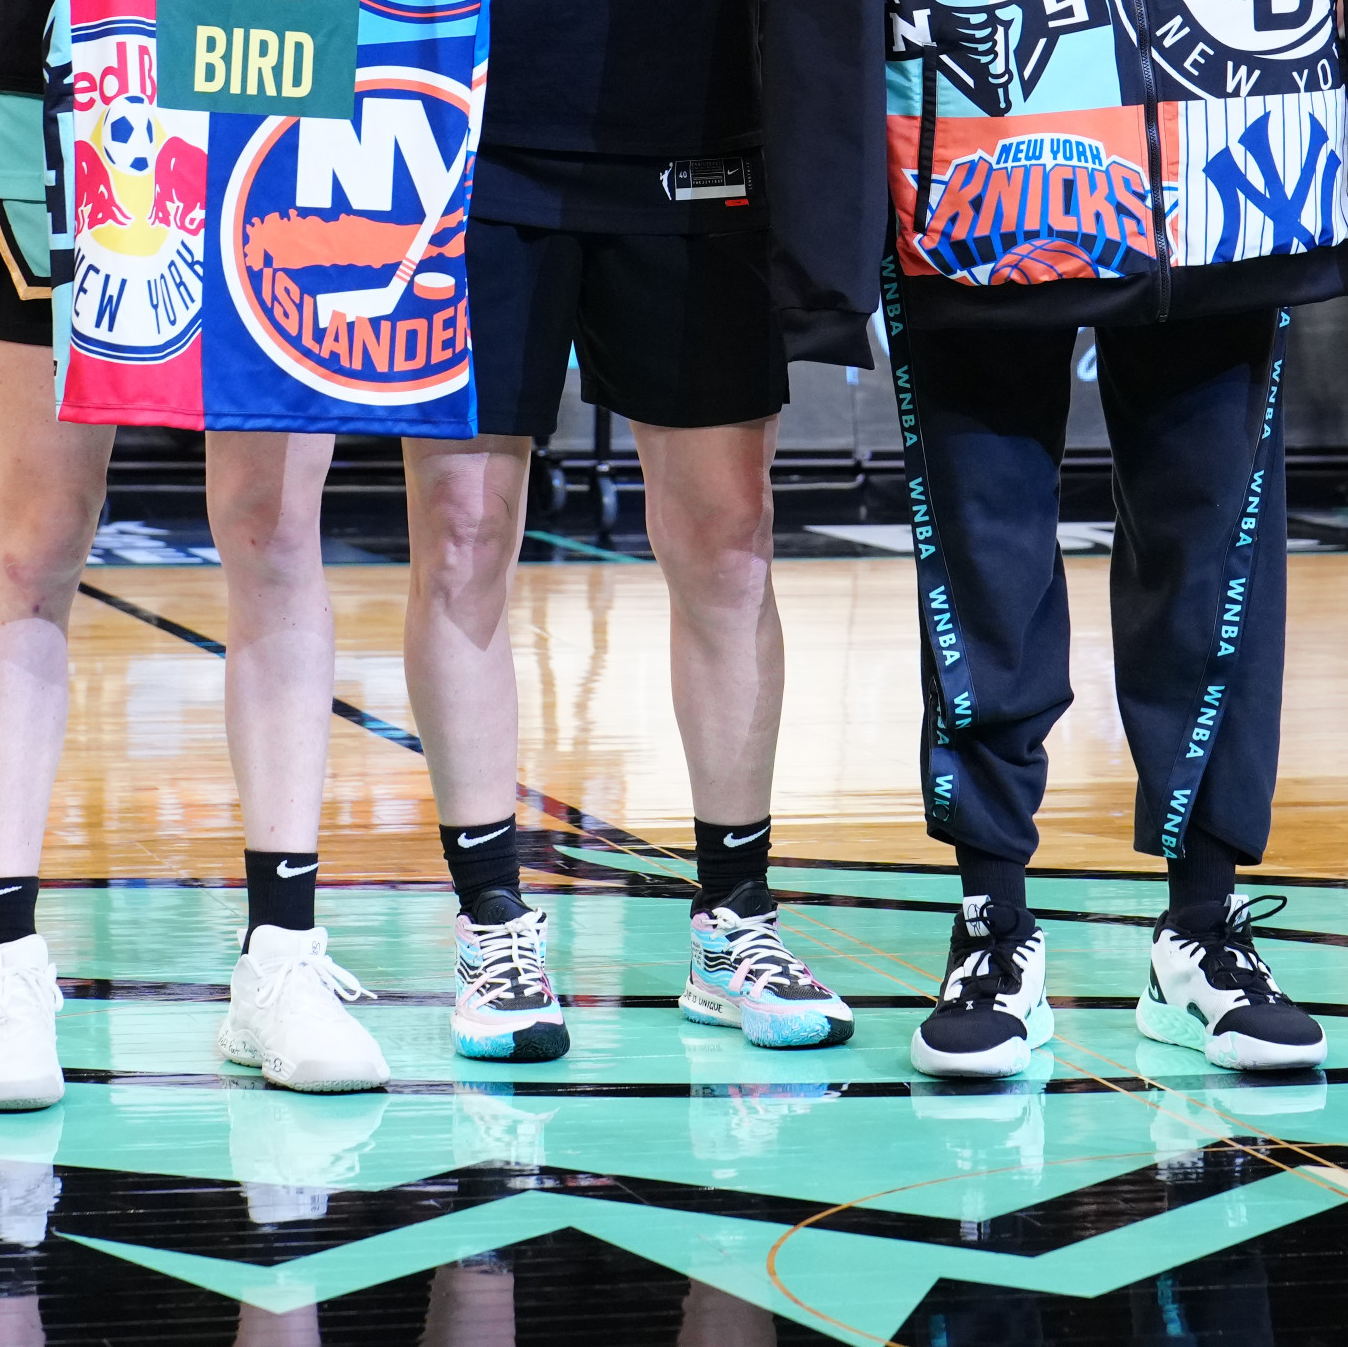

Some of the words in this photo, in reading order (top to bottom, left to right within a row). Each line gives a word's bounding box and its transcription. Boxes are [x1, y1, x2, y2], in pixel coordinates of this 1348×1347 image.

[194, 25, 314, 98] BIRD
[1155, 14, 1261, 98] NEW
[996, 138, 1047, 165] NEW
[1051, 137, 1103, 166] YORK
[919, 157, 1159, 264] KNICKS
[147, 239, 203, 334] YORK
[881, 254, 904, 337] WNBA
[895, 364, 918, 448] WNBA
[1260, 358, 1283, 440] WNBA
[908, 475, 936, 561] WNBA
[1235, 468, 1265, 549] WNBA
[927, 584, 961, 667] WNBA
[1216, 576, 1247, 658] WNBA
[1185, 683, 1226, 761] WNBA
[1161, 789, 1192, 859] WNBA
[698, 997, 723, 1014] UNIQUE
